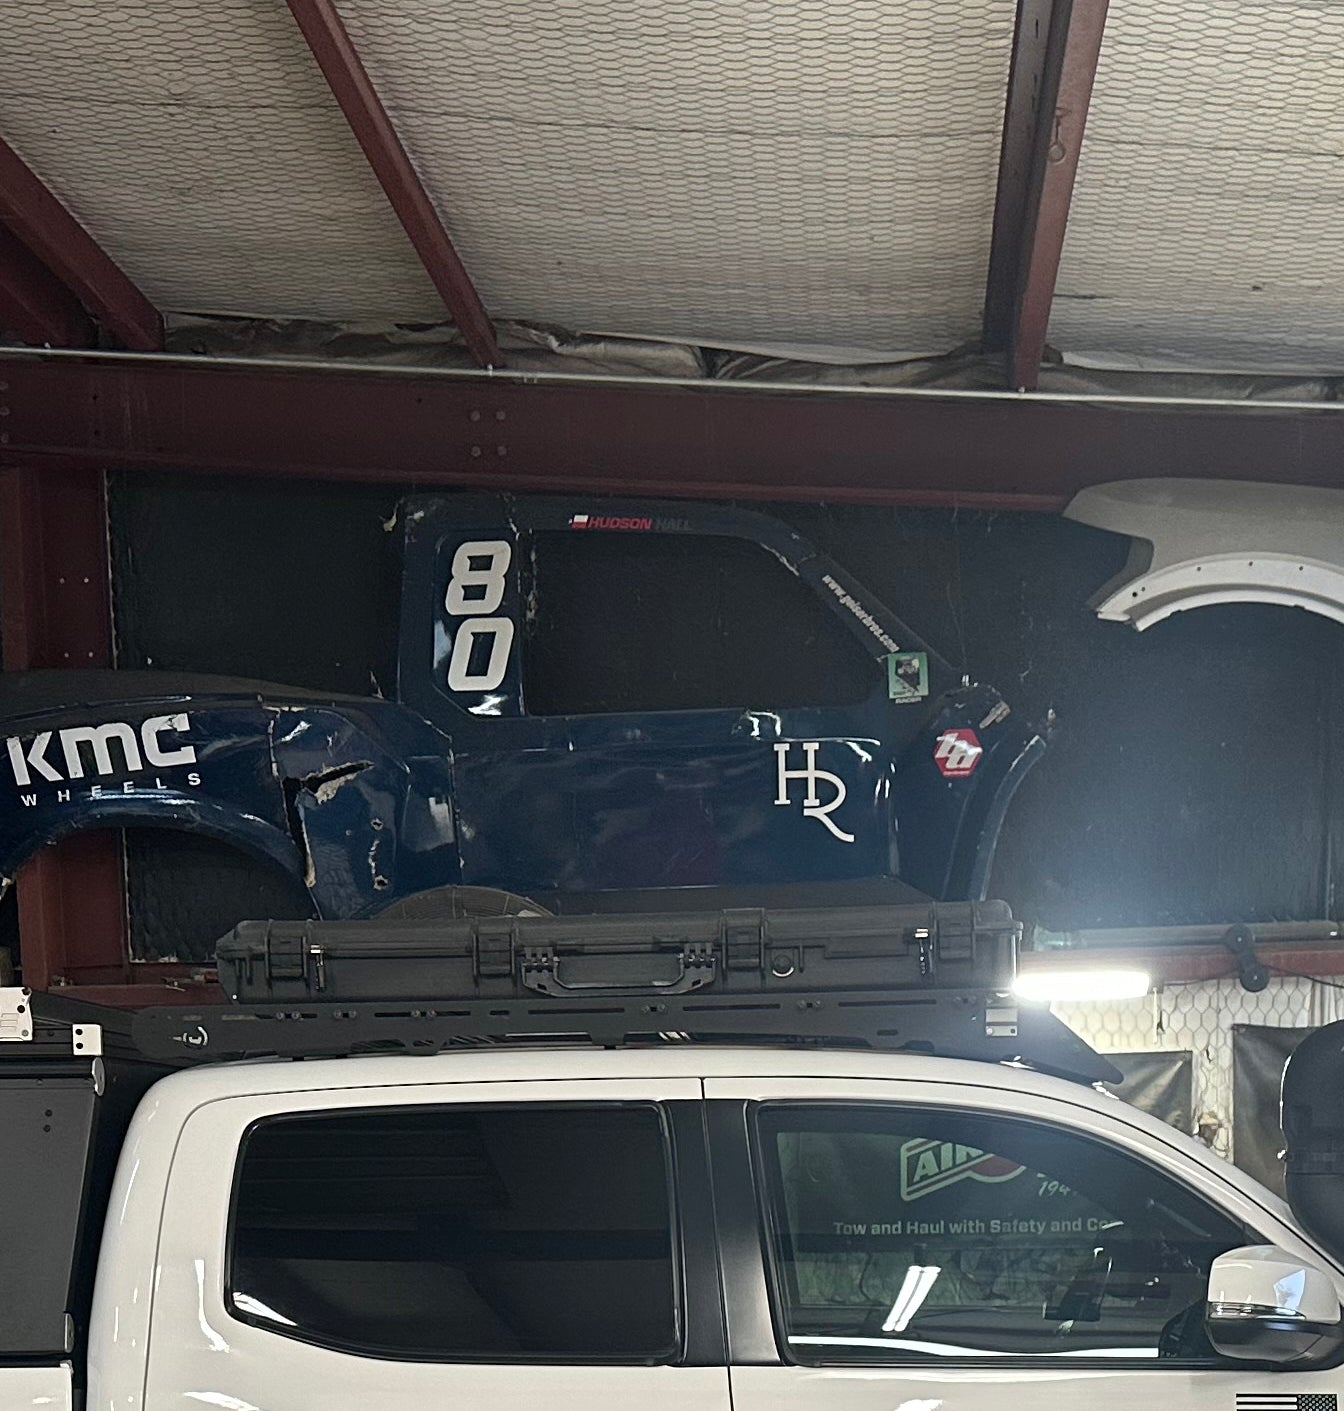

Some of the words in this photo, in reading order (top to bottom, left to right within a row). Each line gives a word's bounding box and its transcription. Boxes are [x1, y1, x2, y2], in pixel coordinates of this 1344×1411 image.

[588, 516, 652, 530] HUDSON
[444, 540, 515, 692] 80
[20, 772, 201, 807] WHEELS
[834, 1221, 867, 1235] Tow
[871, 1221, 902, 1235] and
[906, 1219, 946, 1234] Haul
[948, 1219, 986, 1234] with
[989, 1219, 1041, 1235] Safety
[1044, 1218, 1083, 1232] and
